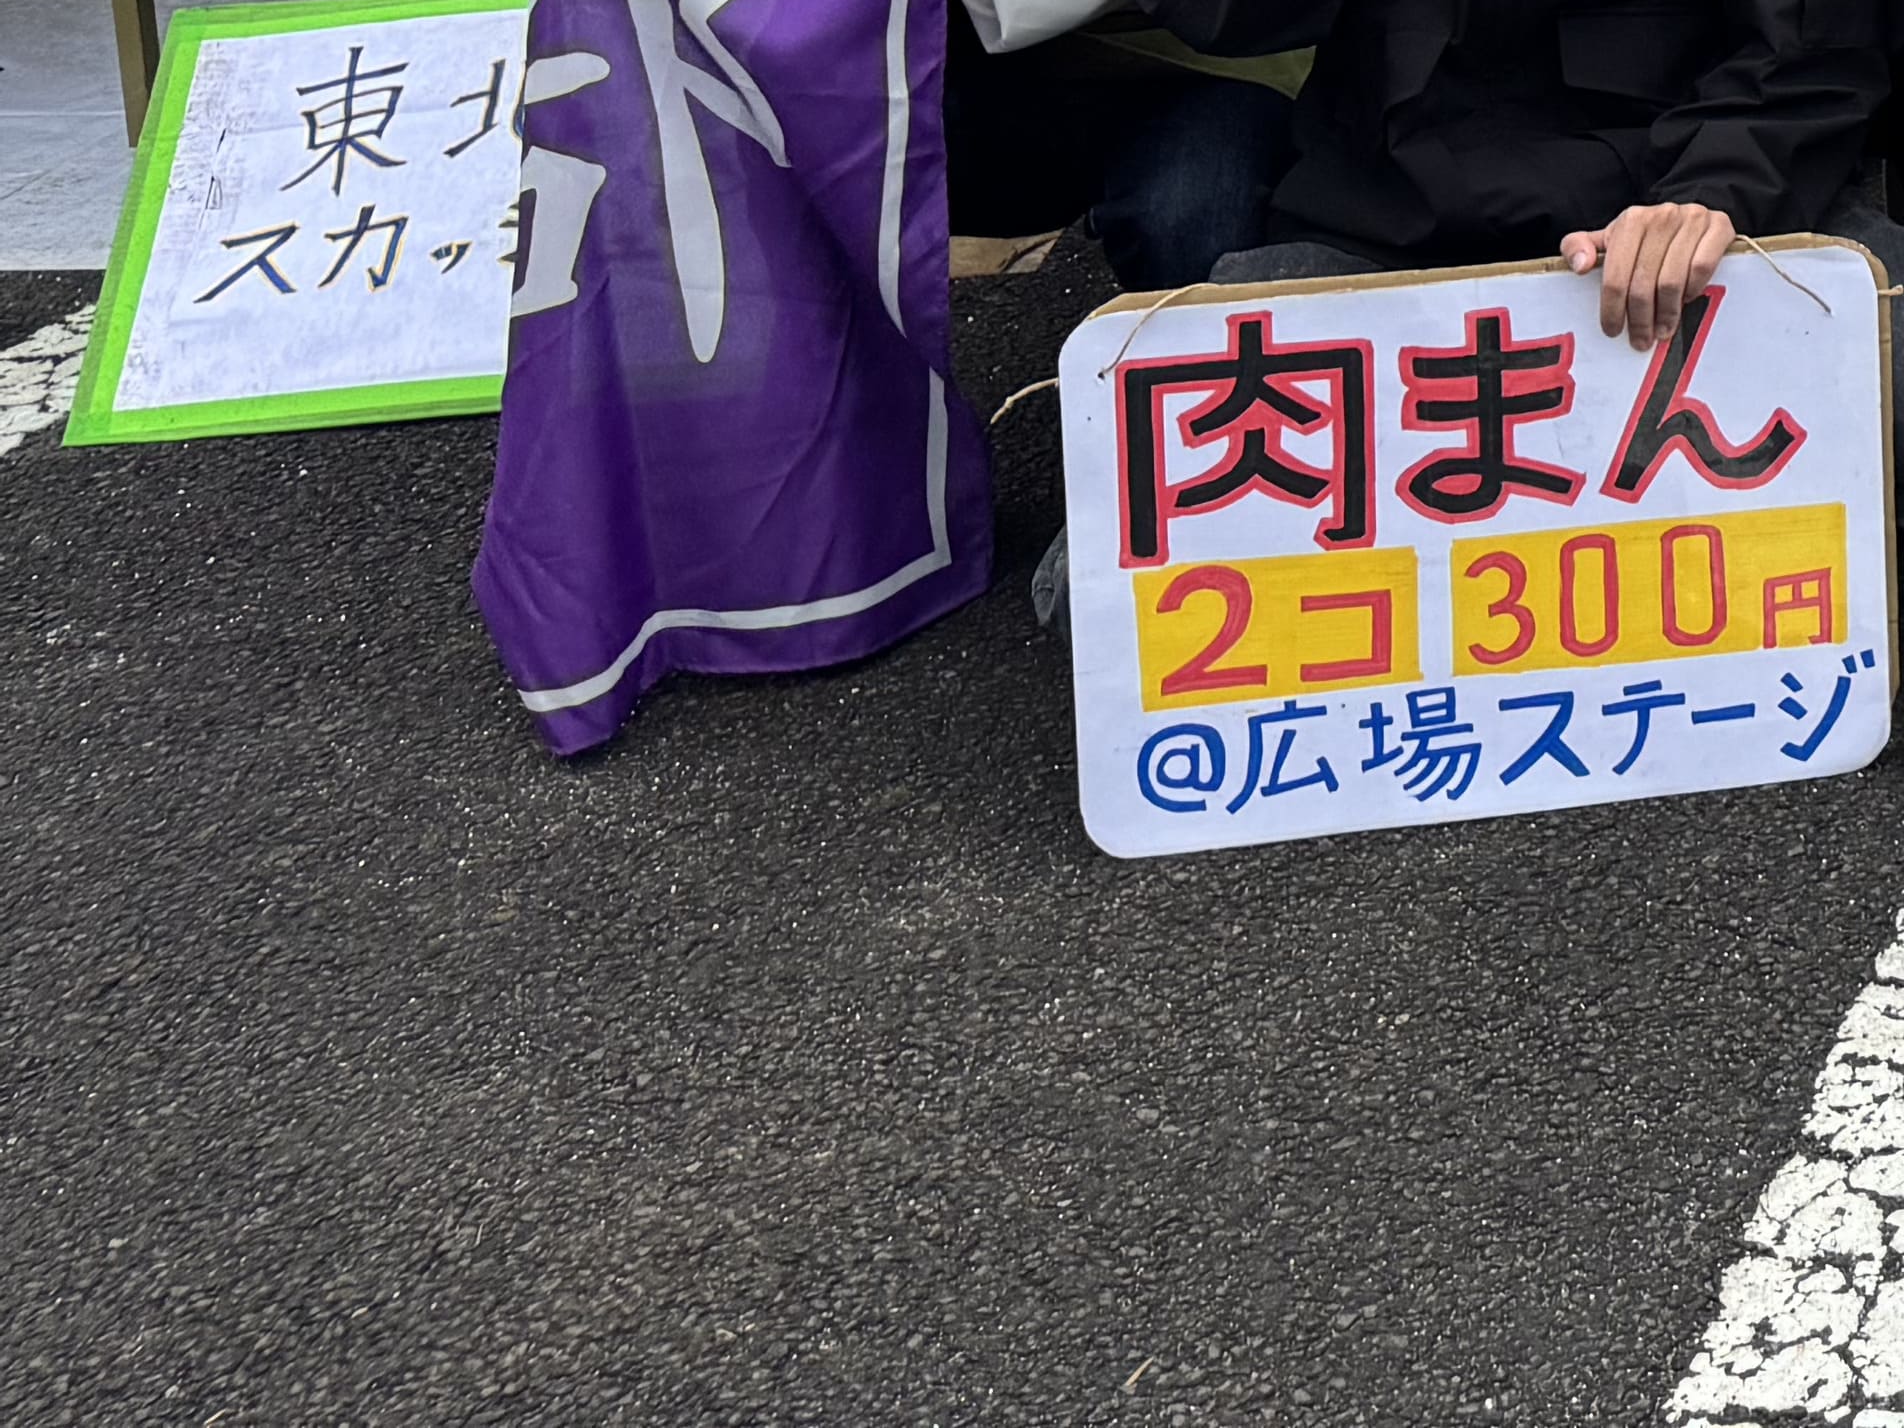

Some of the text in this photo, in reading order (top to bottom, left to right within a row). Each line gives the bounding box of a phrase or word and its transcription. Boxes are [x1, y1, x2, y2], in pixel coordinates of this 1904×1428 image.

[193, 203, 520, 304] スカッ
[1115, 284, 1806, 568] 肉まん
[1138, 649, 1876, 814] @広場ステージ
